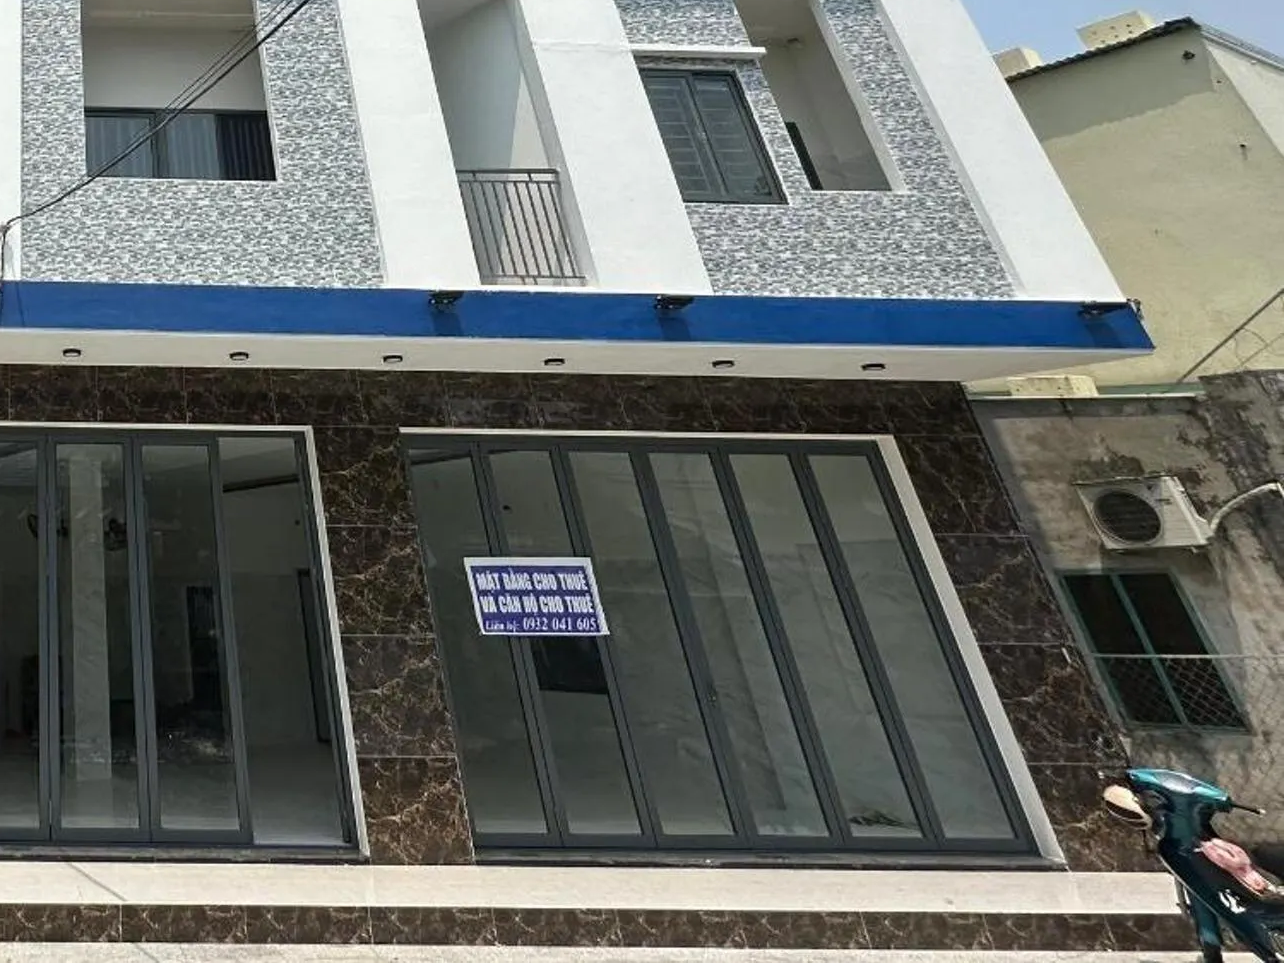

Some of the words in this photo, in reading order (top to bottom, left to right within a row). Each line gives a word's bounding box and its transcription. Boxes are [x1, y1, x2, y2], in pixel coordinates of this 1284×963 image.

[531, 572, 558, 590] CHO
[557, 570, 589, 591] THUÊ
[479, 593, 498, 613] VÀ
[538, 595, 564, 613] CHO
[564, 593, 595, 613] THUÊ
[485, 620, 505, 631] Liên
[523, 617, 548, 630] 0932
[552, 617, 572, 630] 041
[576, 617, 597, 631] 605
